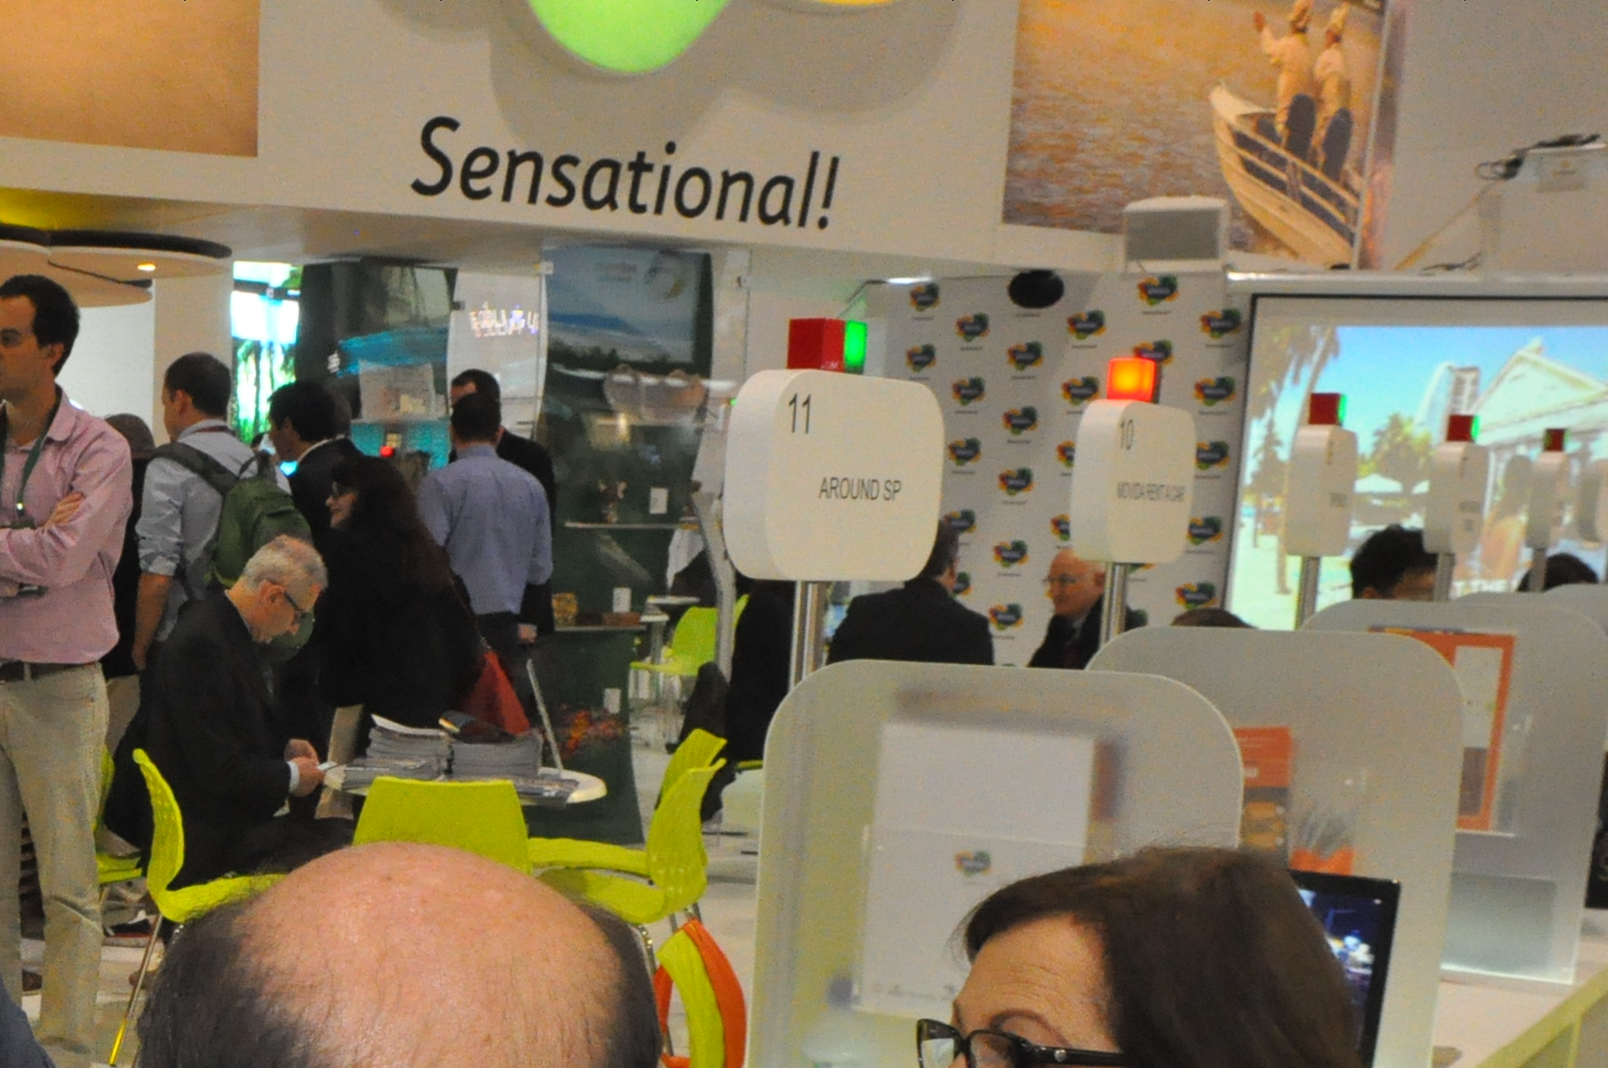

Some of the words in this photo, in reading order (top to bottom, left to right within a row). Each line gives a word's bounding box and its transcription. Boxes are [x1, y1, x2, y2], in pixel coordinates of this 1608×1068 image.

[410, 115, 840, 230] Sensational!
[788, 393, 811, 434] 11
[1120, 418, 1134, 450] 10
[818, 476, 880, 500] AROUND
[883, 480, 902, 501] SP
